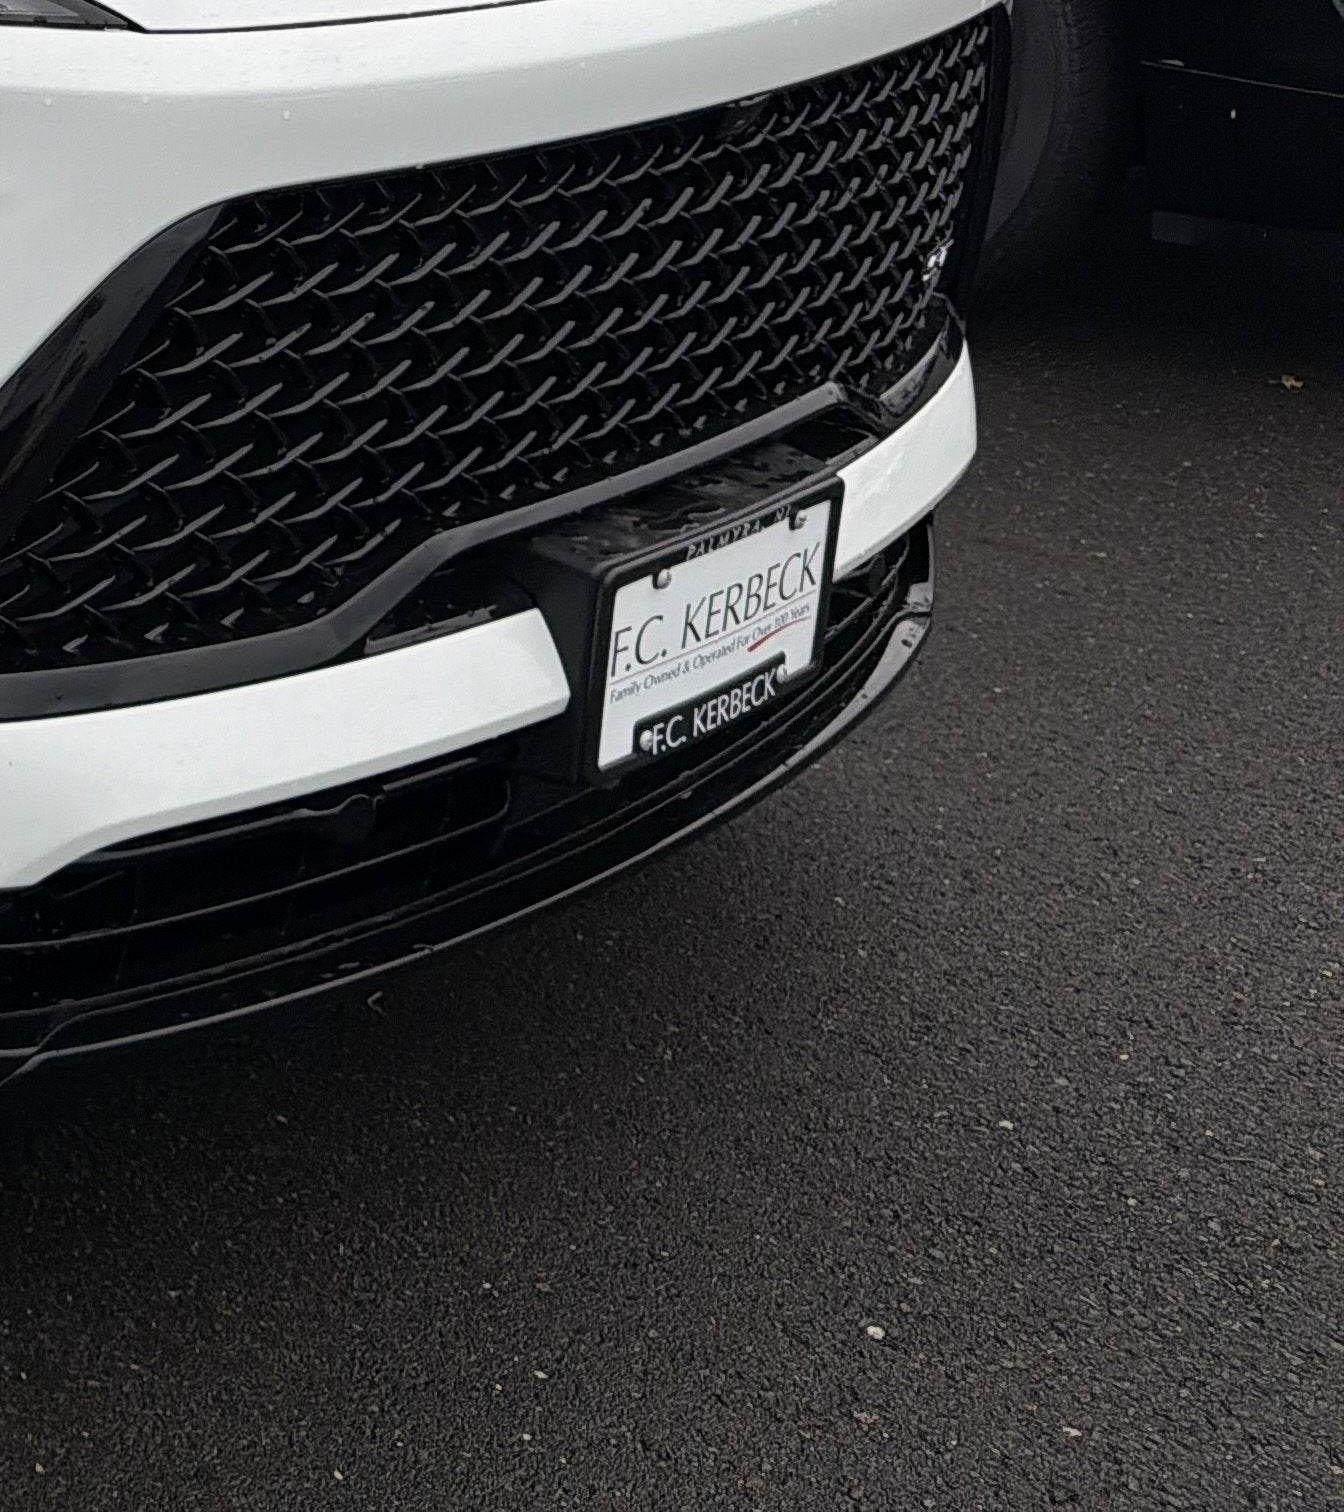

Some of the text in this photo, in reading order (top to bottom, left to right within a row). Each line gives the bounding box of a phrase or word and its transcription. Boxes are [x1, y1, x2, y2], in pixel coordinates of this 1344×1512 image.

[687, 519, 762, 561] PALMYRA
[611, 541, 820, 677] F.C. KERBECK
[610, 681, 642, 704] Family
[644, 663, 681, 690] Owned
[683, 662, 690, 674] &
[692, 639, 735, 672] Operated
[736, 632, 751, 650] For
[652, 668, 777, 756] F.C. KERBECK
